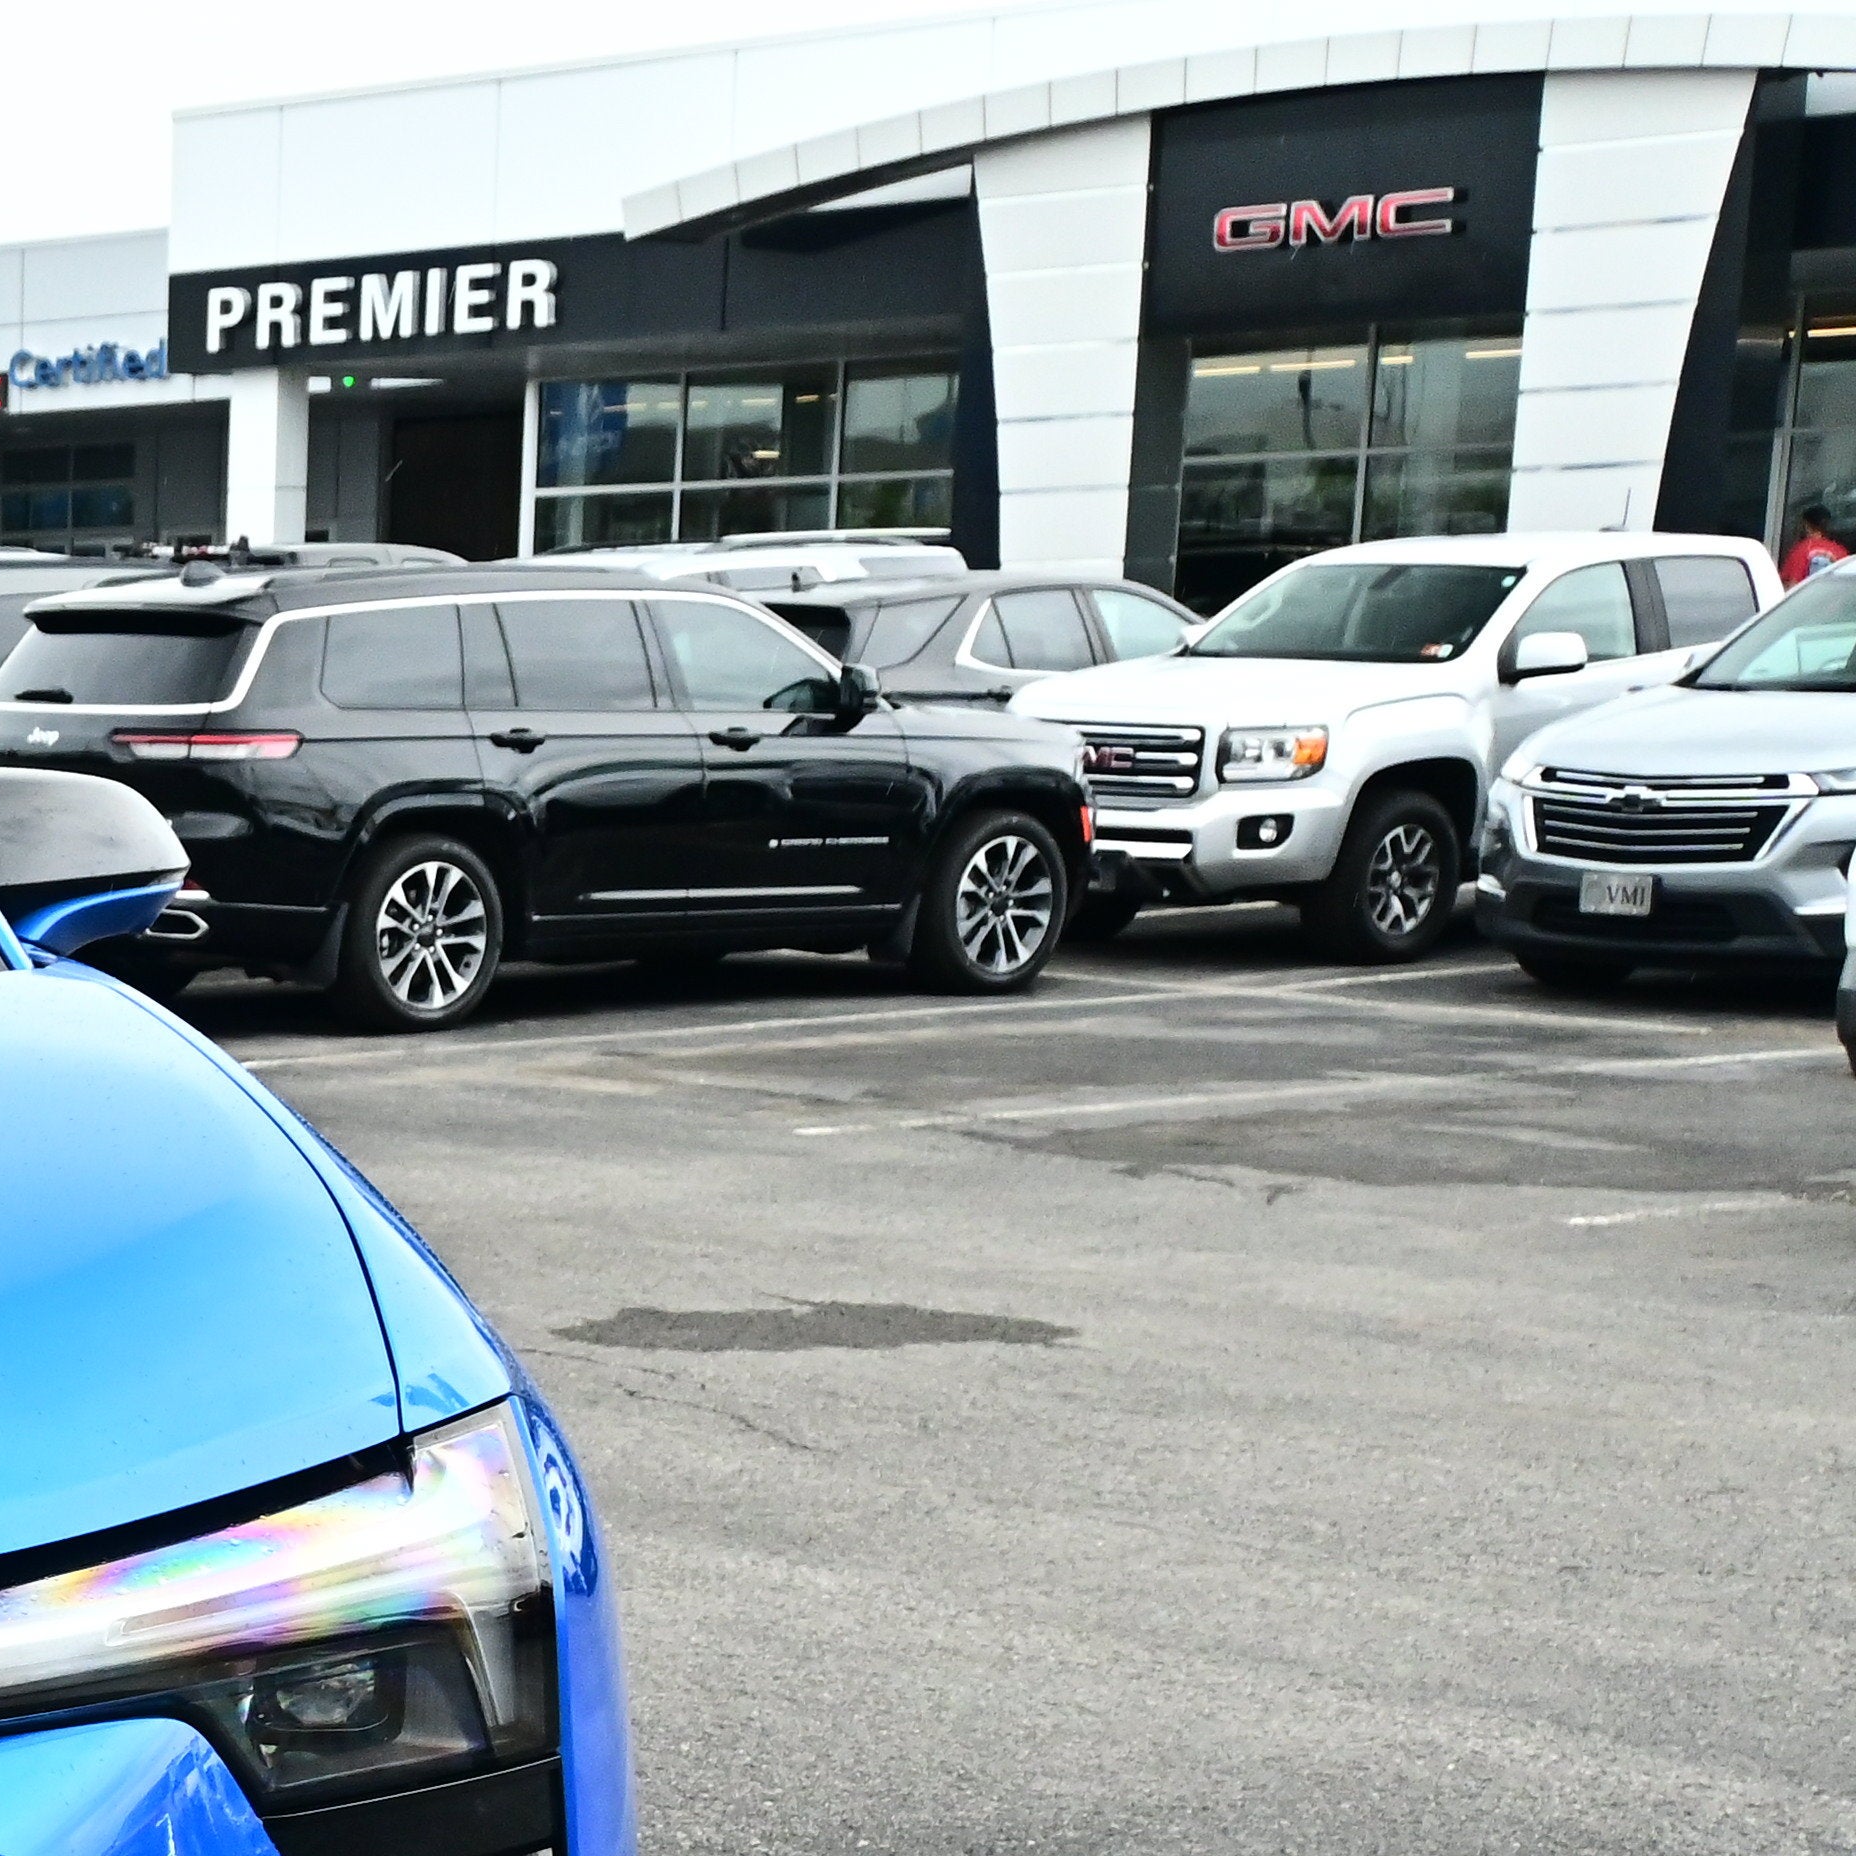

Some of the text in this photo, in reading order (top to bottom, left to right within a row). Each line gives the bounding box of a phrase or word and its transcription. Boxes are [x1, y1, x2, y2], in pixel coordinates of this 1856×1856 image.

[1213, 186, 1455, 252] GMC
[205, 258, 559, 354] PREMIER
[9, 337, 168, 389] Certified
[1082, 745, 1134, 768] MC
